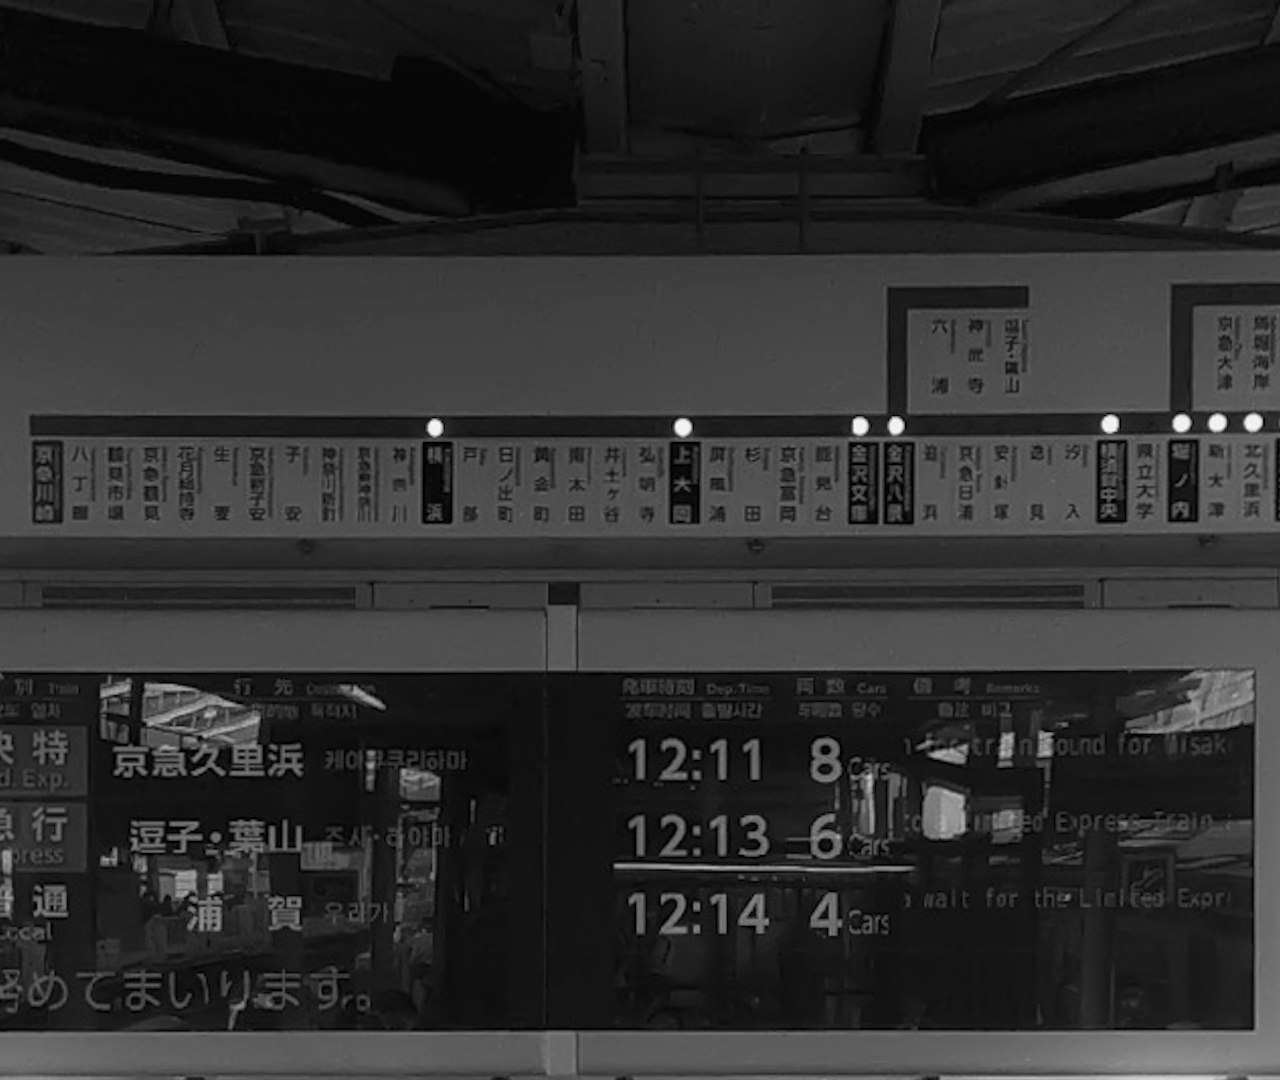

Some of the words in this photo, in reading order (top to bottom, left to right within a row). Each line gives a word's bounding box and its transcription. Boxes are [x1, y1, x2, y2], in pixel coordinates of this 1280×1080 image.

[23, 768, 70, 793] Exp.
[112, 743, 305, 779] 京急久里浜
[628, 738, 761, 781] 12:11
[810, 737, 843, 784] 8
[848, 757, 889, 784] Cars
[129, 819, 303, 855] 逗子・葉山
[628, 815, 770, 858] 12:13
[810, 814, 843, 860] 6
[848, 833, 889, 862] Cars
[628, 892, 770, 936] 12:14
[810, 892, 843, 937] 4
[847, 909, 889, 940] Cars
